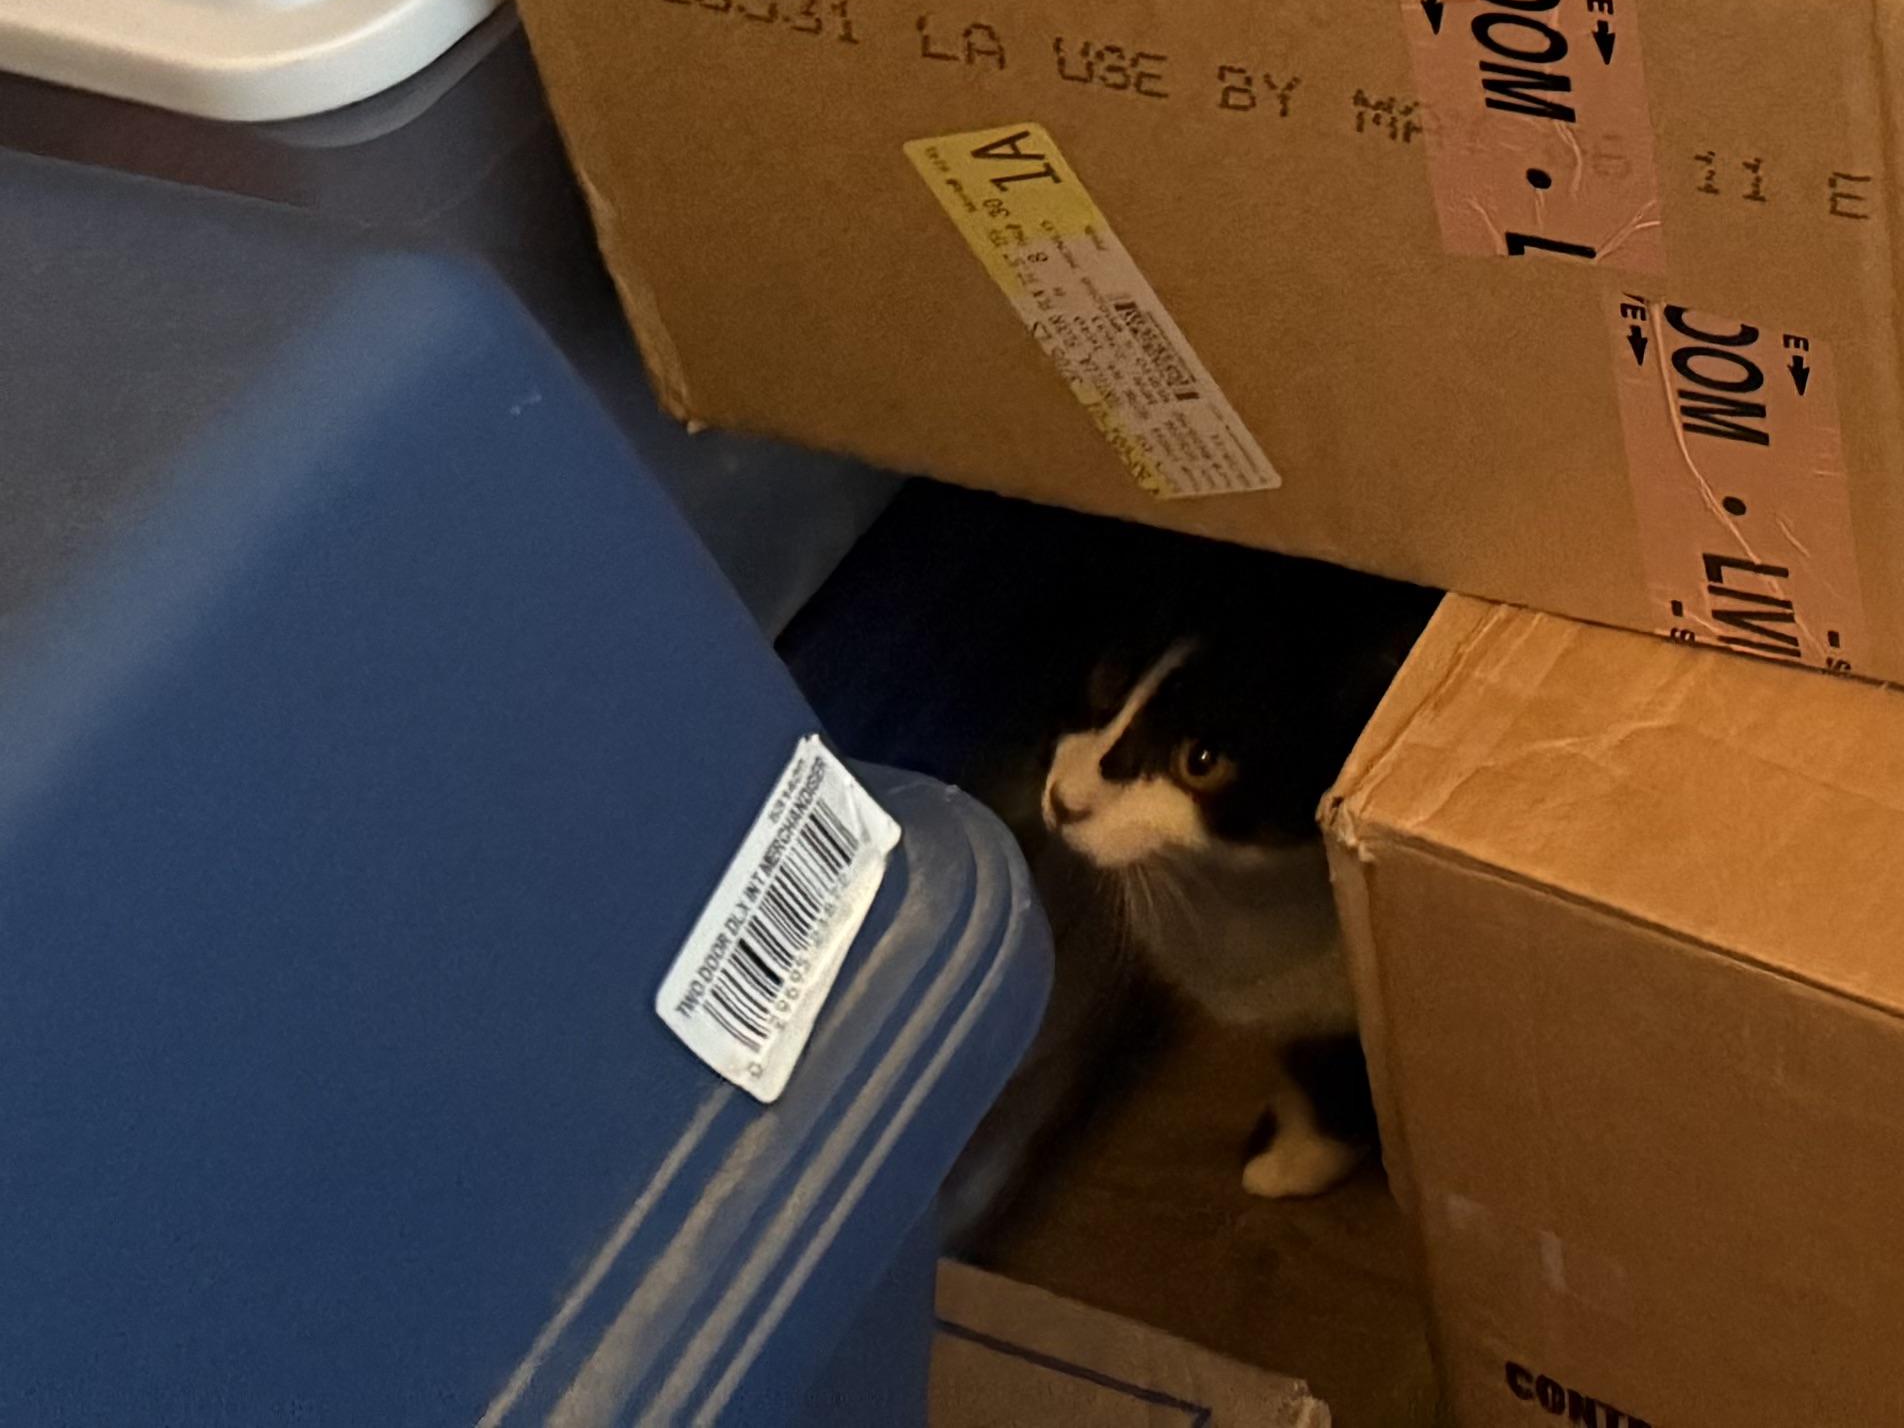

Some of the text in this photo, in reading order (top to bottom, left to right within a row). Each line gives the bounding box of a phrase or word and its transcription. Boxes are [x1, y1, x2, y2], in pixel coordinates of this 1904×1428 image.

[915, 12, 1007, 71] LA
[1052, 33, 1170, 99] USE
[1217, 63, 1301, 118] BY
[1827, 171, 1875, 221] E
[696, 932, 731, 984] DOOR
